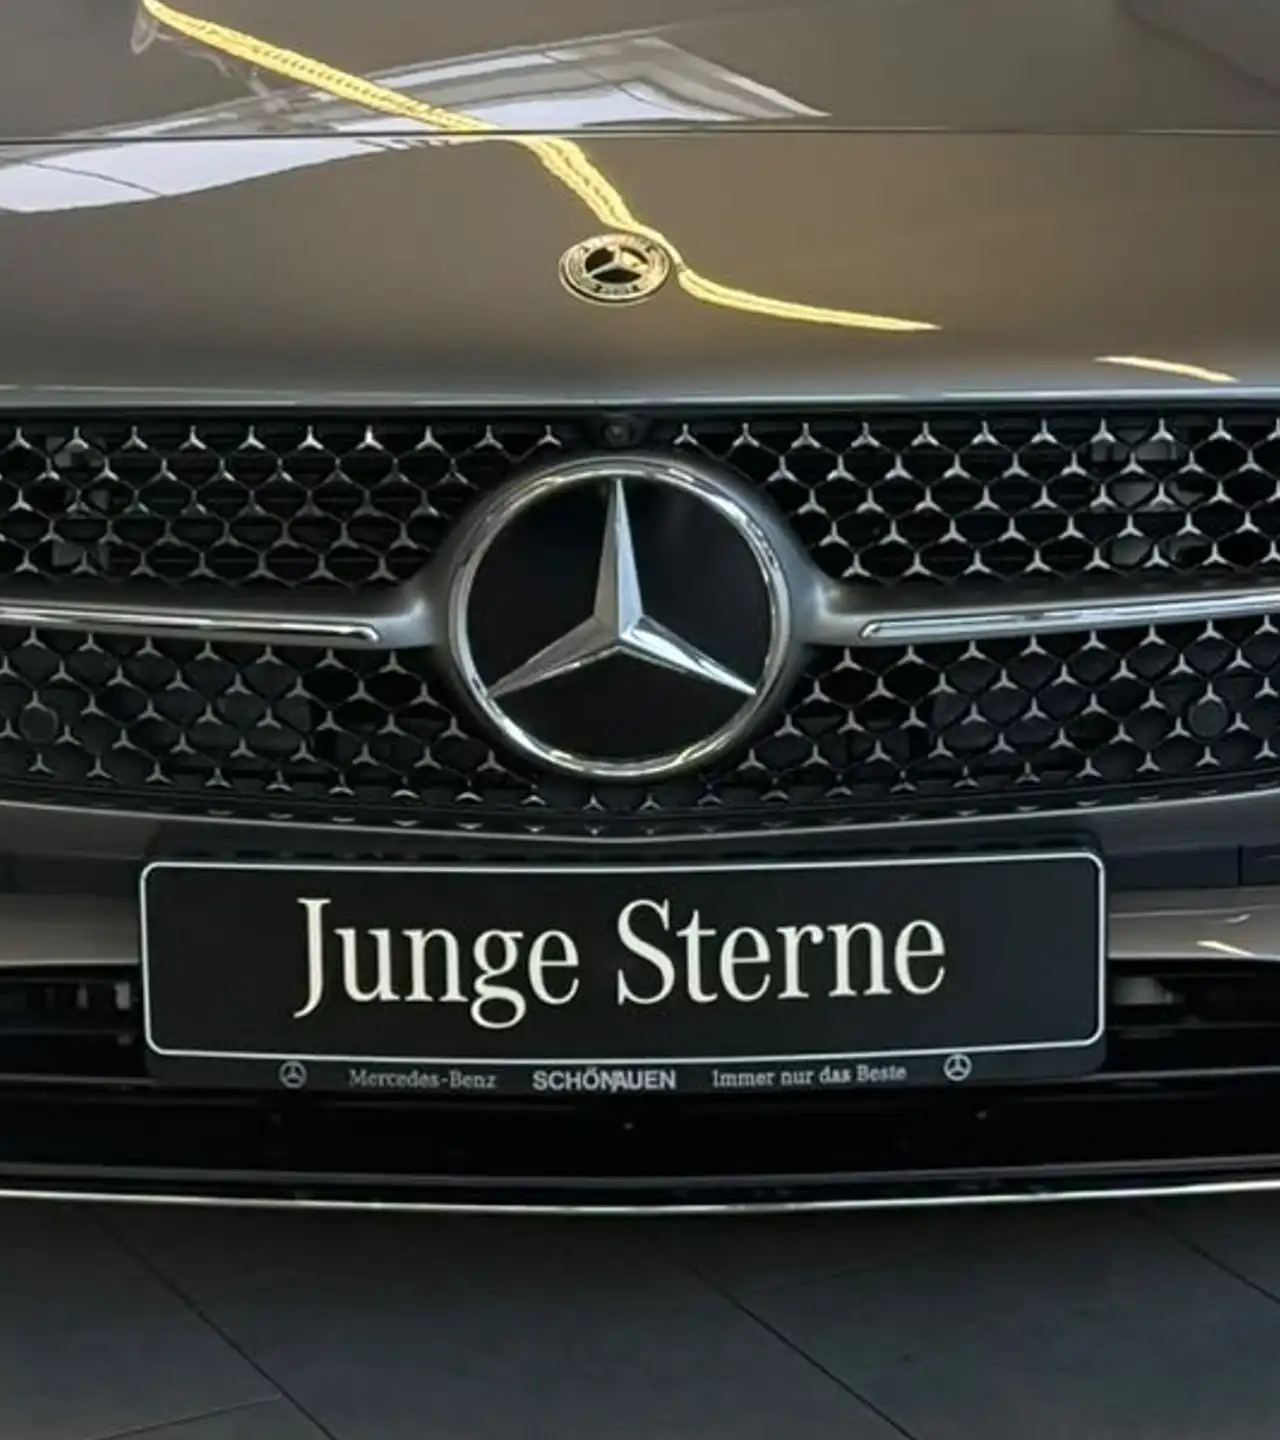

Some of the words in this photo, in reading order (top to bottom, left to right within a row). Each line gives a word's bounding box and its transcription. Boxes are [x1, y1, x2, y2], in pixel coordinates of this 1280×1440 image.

[293, 897, 580, 1029] Junge
[617, 899, 946, 1006] Sterne
[348, 1068, 498, 1089] Mercedes-Benz
[532, 1066, 677, 1091] SCHÖNAUEN
[711, 1069, 776, 1088] Immer
[780, 1069, 815, 1086] nur
[819, 1065, 852, 1084] das
[856, 1063, 908, 1082] Beste
